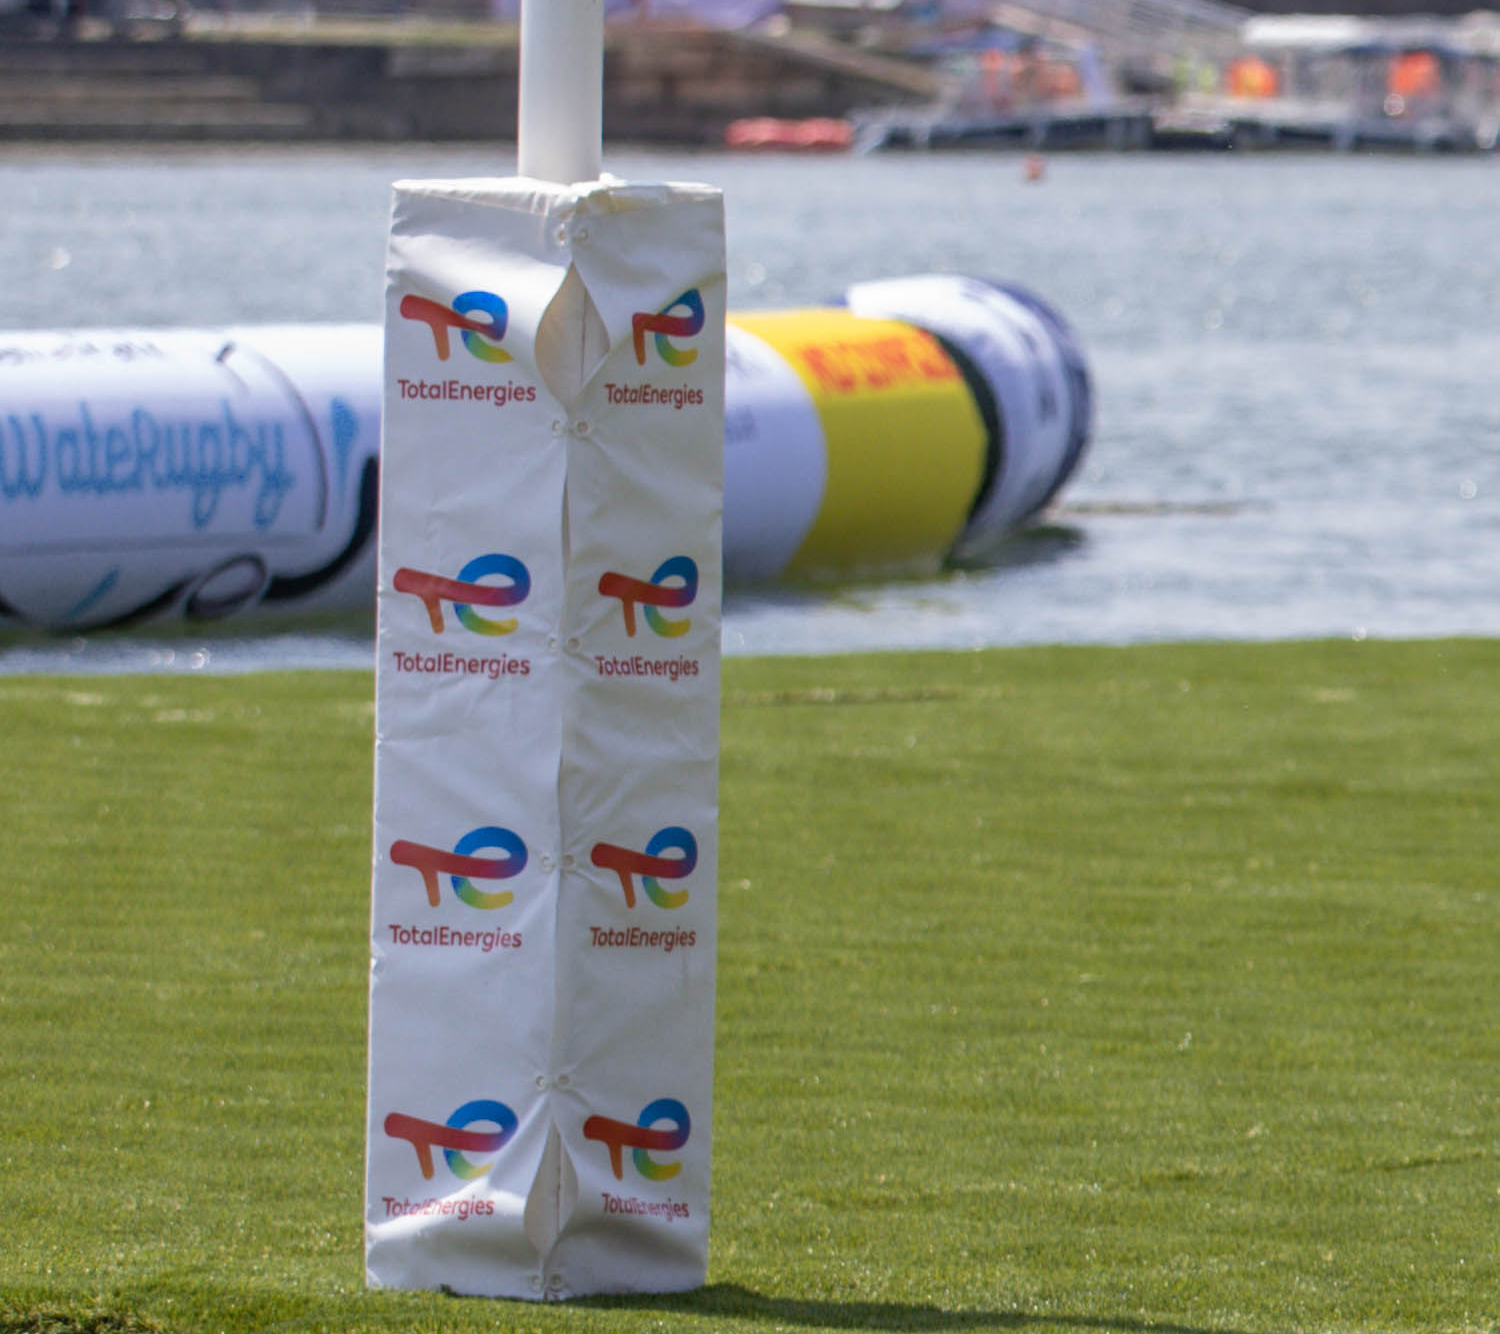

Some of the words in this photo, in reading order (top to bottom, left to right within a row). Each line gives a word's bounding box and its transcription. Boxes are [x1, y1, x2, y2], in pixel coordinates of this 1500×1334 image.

[397, 378, 536, 407] TotalEnergies
[604, 383, 704, 409] TotalEnergies
[0, 397, 294, 530] WateRugby
[392, 651, 531, 680] TotalEnergies
[594, 655, 699, 681] TotalEnergies
[388, 923, 523, 953] TotalEnergies
[589, 926, 697, 952] TotalEnergies
[382, 1195, 495, 1222] TotalEnergies
[601, 1192, 690, 1222] TotalEnergies
